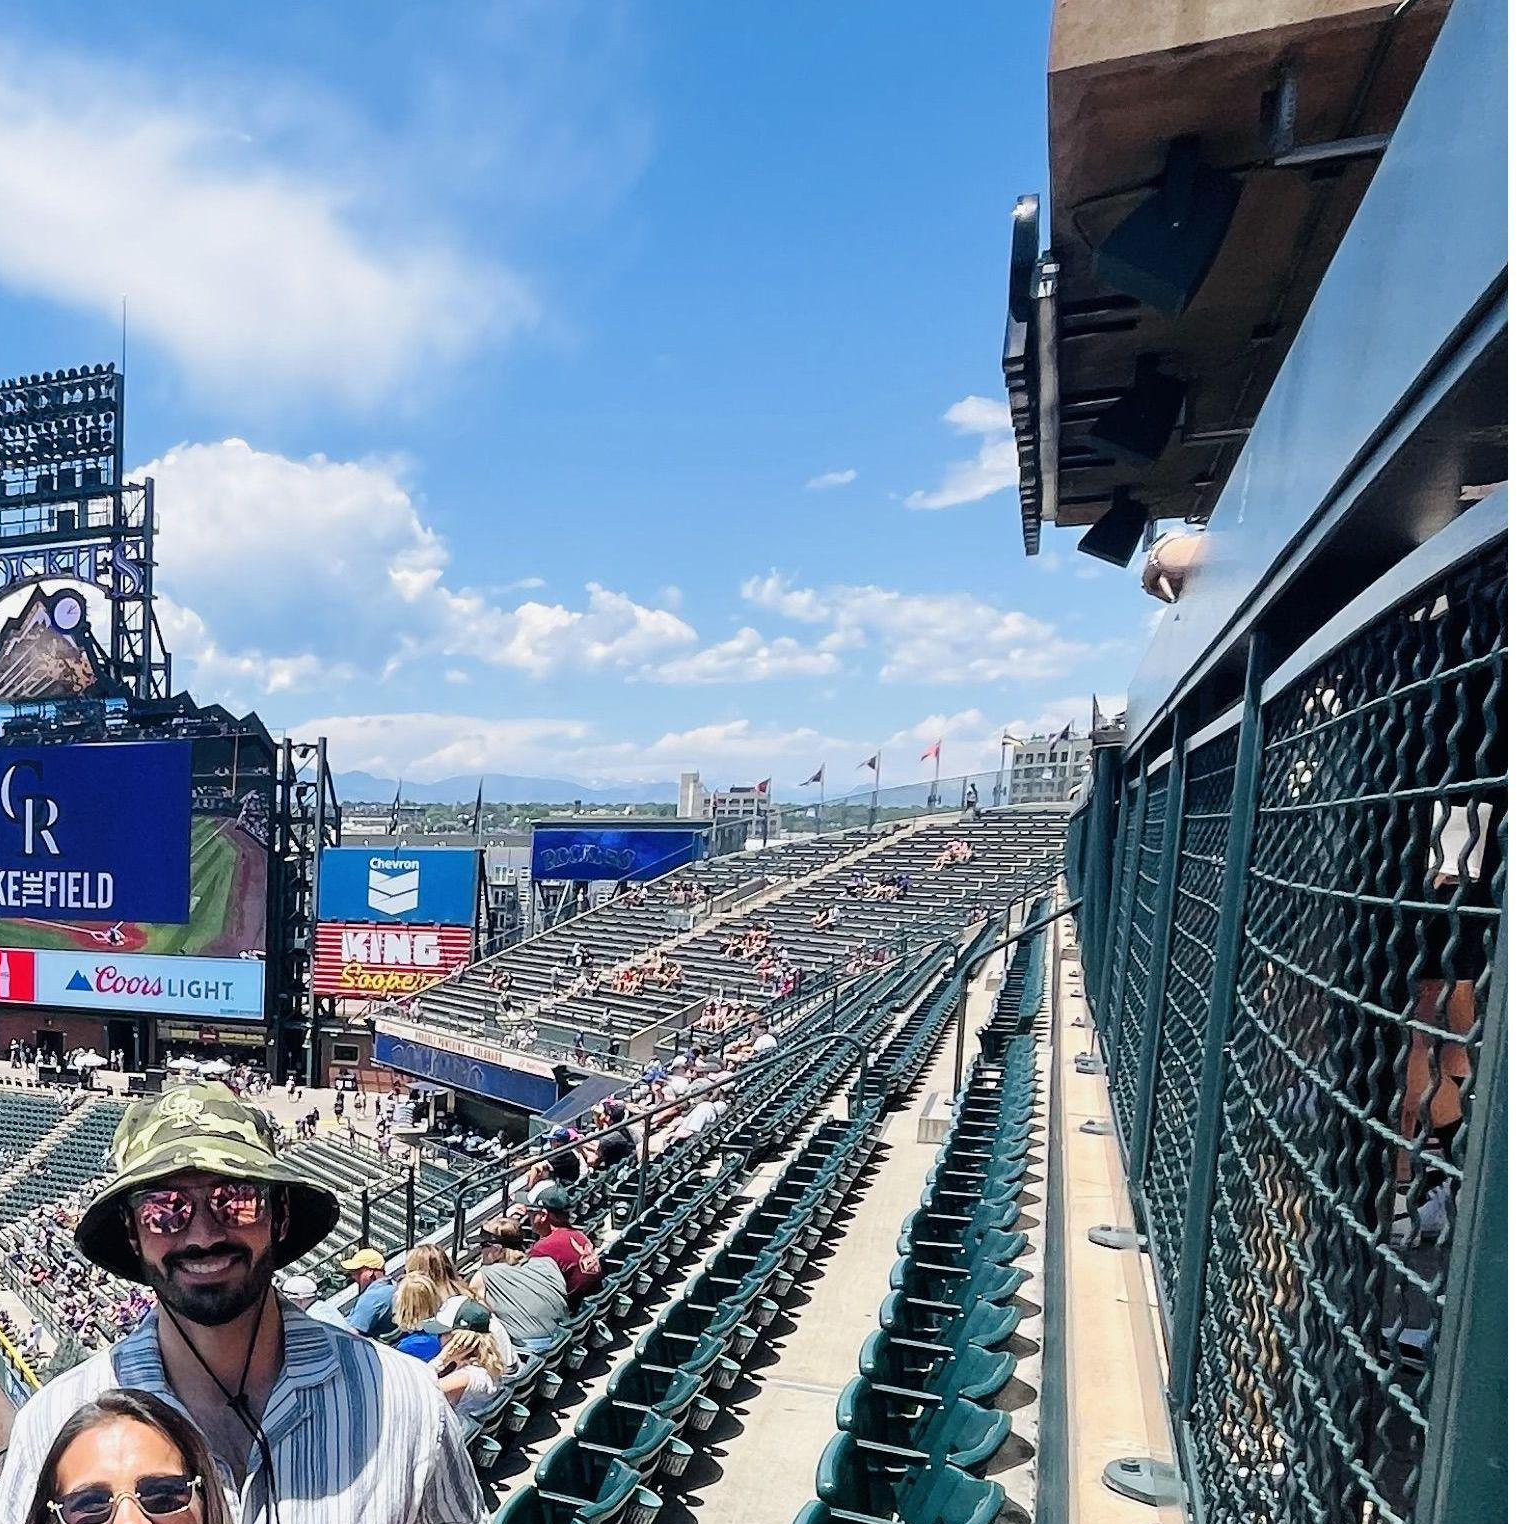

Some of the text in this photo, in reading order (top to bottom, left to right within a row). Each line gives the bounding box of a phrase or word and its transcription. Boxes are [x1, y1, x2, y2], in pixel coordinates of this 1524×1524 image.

[369, 857, 420, 870] Chevron
[22, 870, 44, 907] THE
[45, 871, 114, 909] FIELD
[341, 931, 441, 966] KING
[95, 965, 234, 1001] Coors LIGHT
